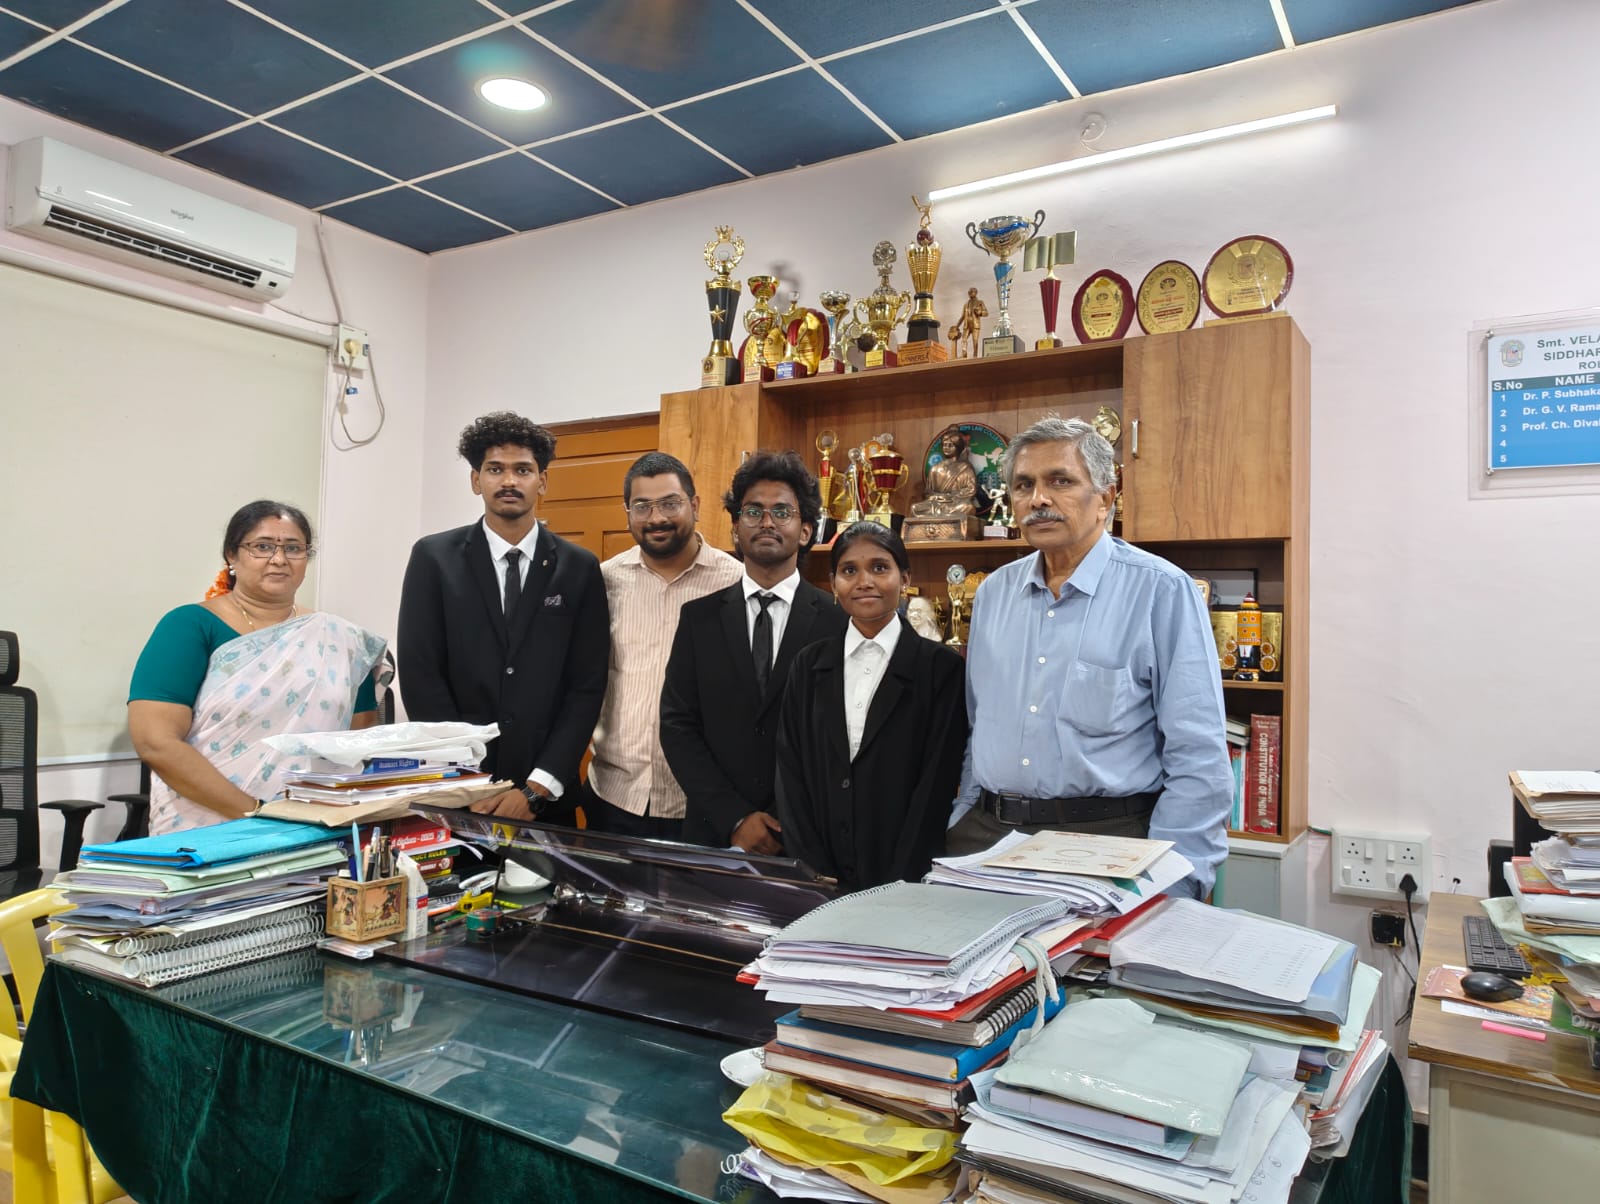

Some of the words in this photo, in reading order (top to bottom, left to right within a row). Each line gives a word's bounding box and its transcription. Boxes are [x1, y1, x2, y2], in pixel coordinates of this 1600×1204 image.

[1537, 338, 1565, 348] Smt.
[1493, 381, 1523, 391] S.No
[1555, 374, 1595, 386] NAME
[1500, 394, 1506, 402] 1
[1523, 392, 1539, 401] Dr.
[1541, 391, 1551, 400] P.
[1500, 409, 1507, 417] 2
[1522, 407, 1538, 416] Dr.
[1541, 405, 1553, 414] G.
[1556, 404, 1567, 413] V.
[1500, 424, 1507, 432] 3
[1522, 422, 1548, 431] Prof.
[1551, 420, 1570, 430] Ch.
[1499, 439, 1507, 447] 4
[1500, 454, 1507, 462] 5
[1258, 732, 1269, 785] CONSTITUTION
[1258, 786, 1268, 796] OF
[1257, 796, 1268, 816] INDIA
